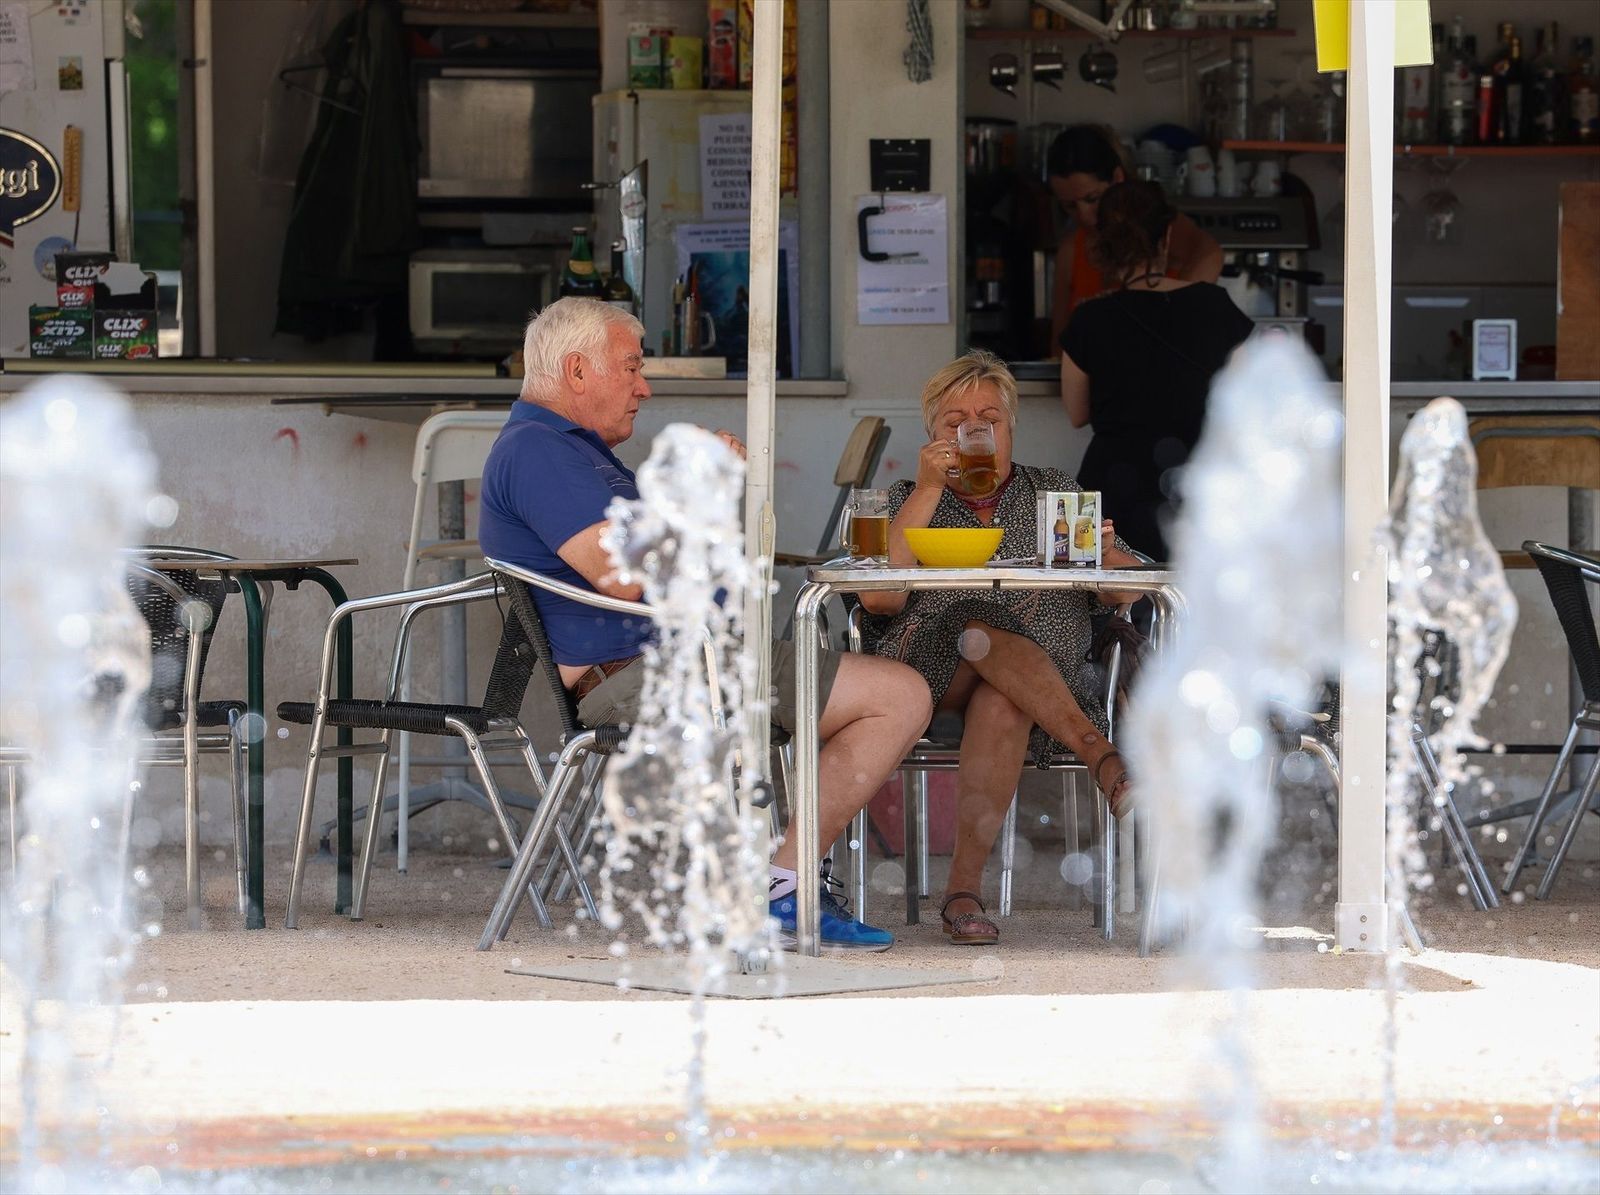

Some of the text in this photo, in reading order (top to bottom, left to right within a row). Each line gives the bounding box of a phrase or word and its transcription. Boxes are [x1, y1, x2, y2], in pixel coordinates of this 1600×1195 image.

[60, 292, 86, 302] CLIX
[103, 318, 144, 331] CLIX
[97, 344, 123, 353] CLIX
